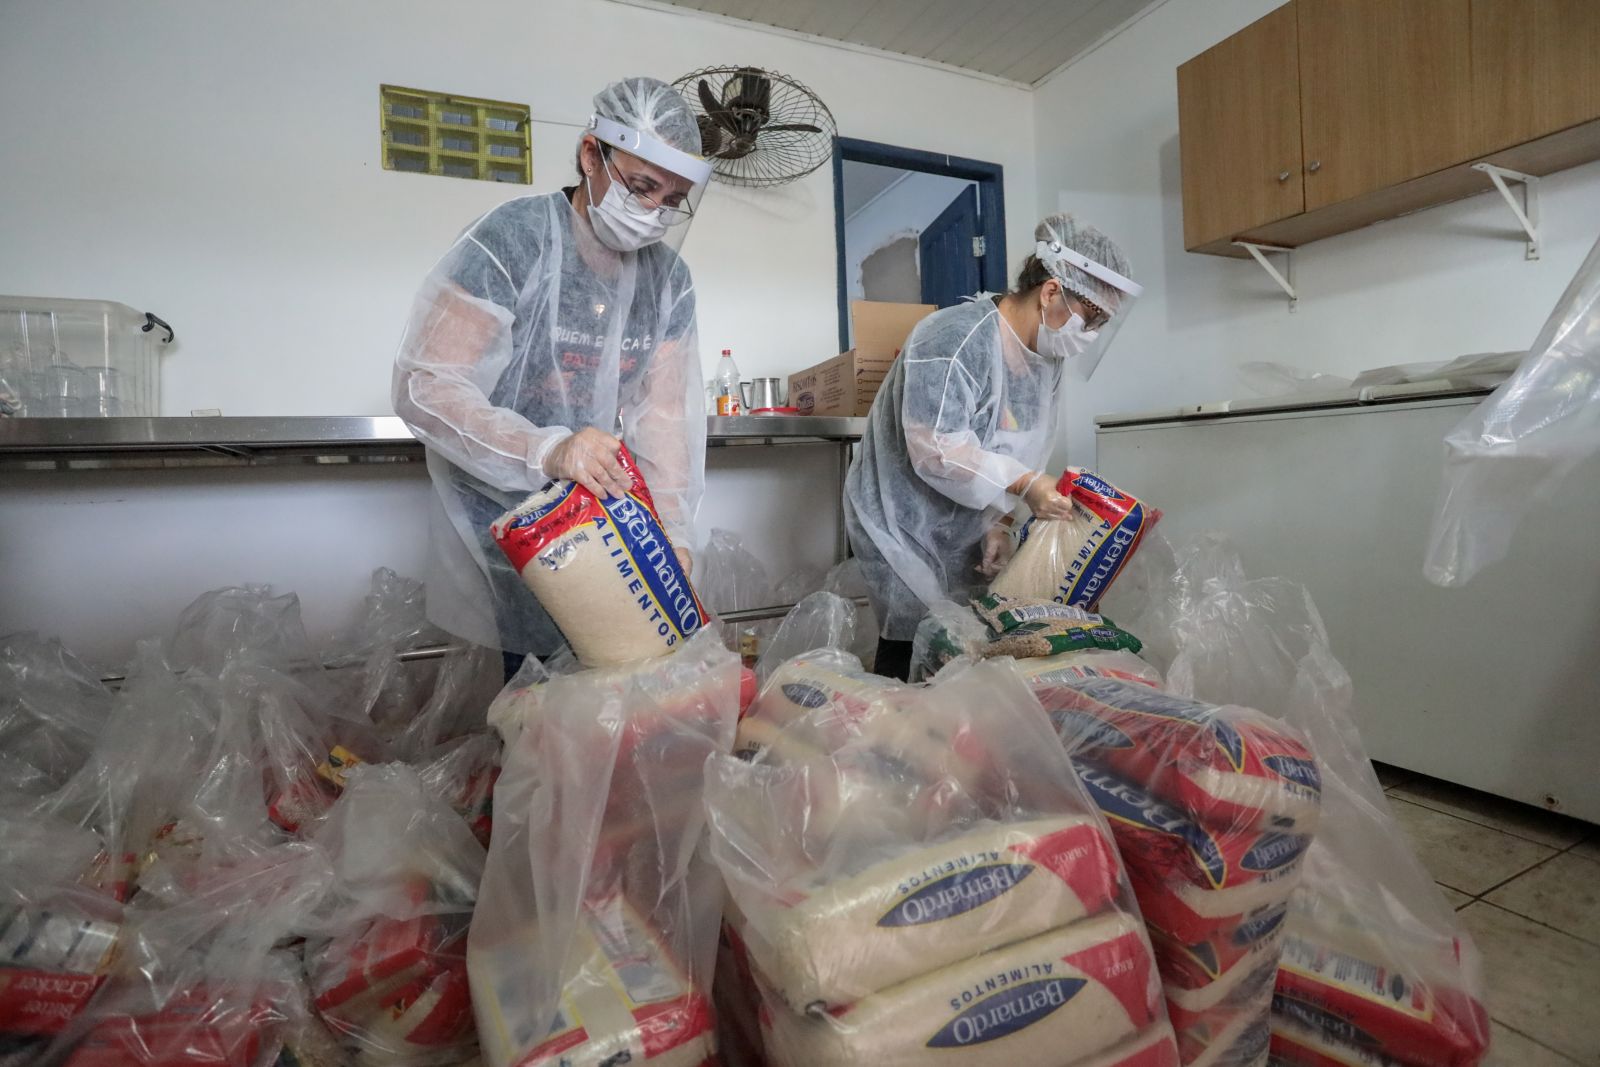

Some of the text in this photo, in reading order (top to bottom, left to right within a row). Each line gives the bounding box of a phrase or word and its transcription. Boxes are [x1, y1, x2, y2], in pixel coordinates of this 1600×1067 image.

[594, 336, 639, 350] ECA
[592, 516, 677, 647] ALIMENTOS
[1053, 520, 1112, 604] ALIMENTO
[897, 851, 1001, 893] ALIMENTOS
[950, 962, 1054, 1011] ALIMENTOS
